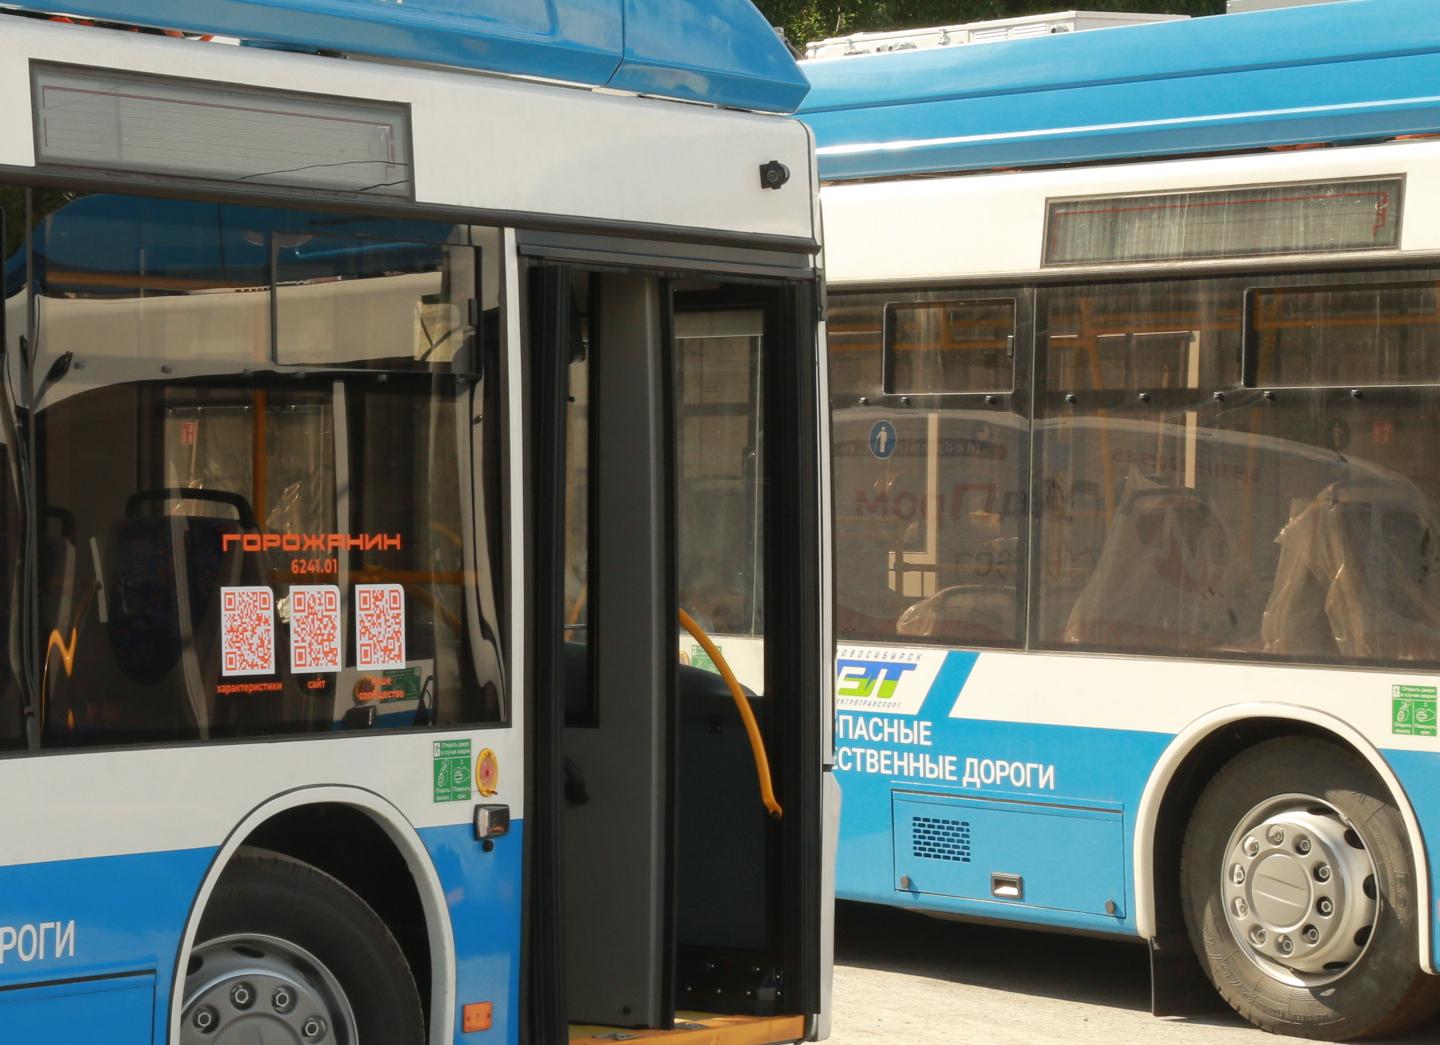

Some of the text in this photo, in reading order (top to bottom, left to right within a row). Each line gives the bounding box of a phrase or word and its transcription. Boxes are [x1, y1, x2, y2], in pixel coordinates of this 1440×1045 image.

[222, 533, 401, 552] ГОРОЖАНИН
[291, 559, 337, 574] 6241.01
[837, 648, 923, 661] ОВОСИБИРСК
[217, 681, 283, 695] характеристики
[307, 678, 326, 689] сайт
[836, 714, 932, 746] ПАСНЫЕ
[832, 746, 1055, 790] СТВЕННЫЕ ДОРОГИ
